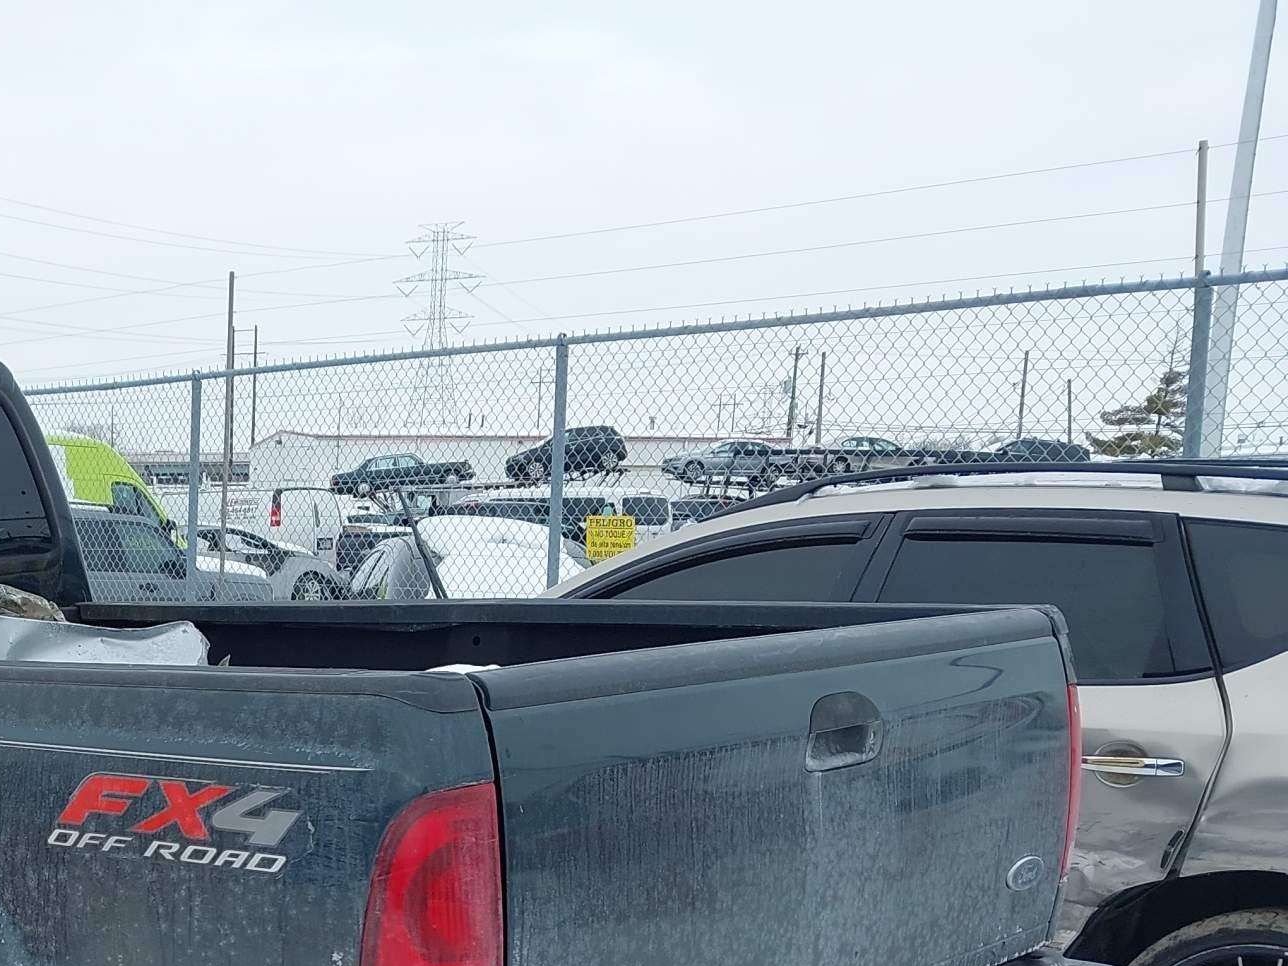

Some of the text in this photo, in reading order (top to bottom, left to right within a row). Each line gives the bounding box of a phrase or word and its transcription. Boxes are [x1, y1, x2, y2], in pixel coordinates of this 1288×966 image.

[589, 518, 633, 528] PELIGRO
[57, 774, 304, 848] FX4
[47, 829, 287, 873] OFF ROAD
